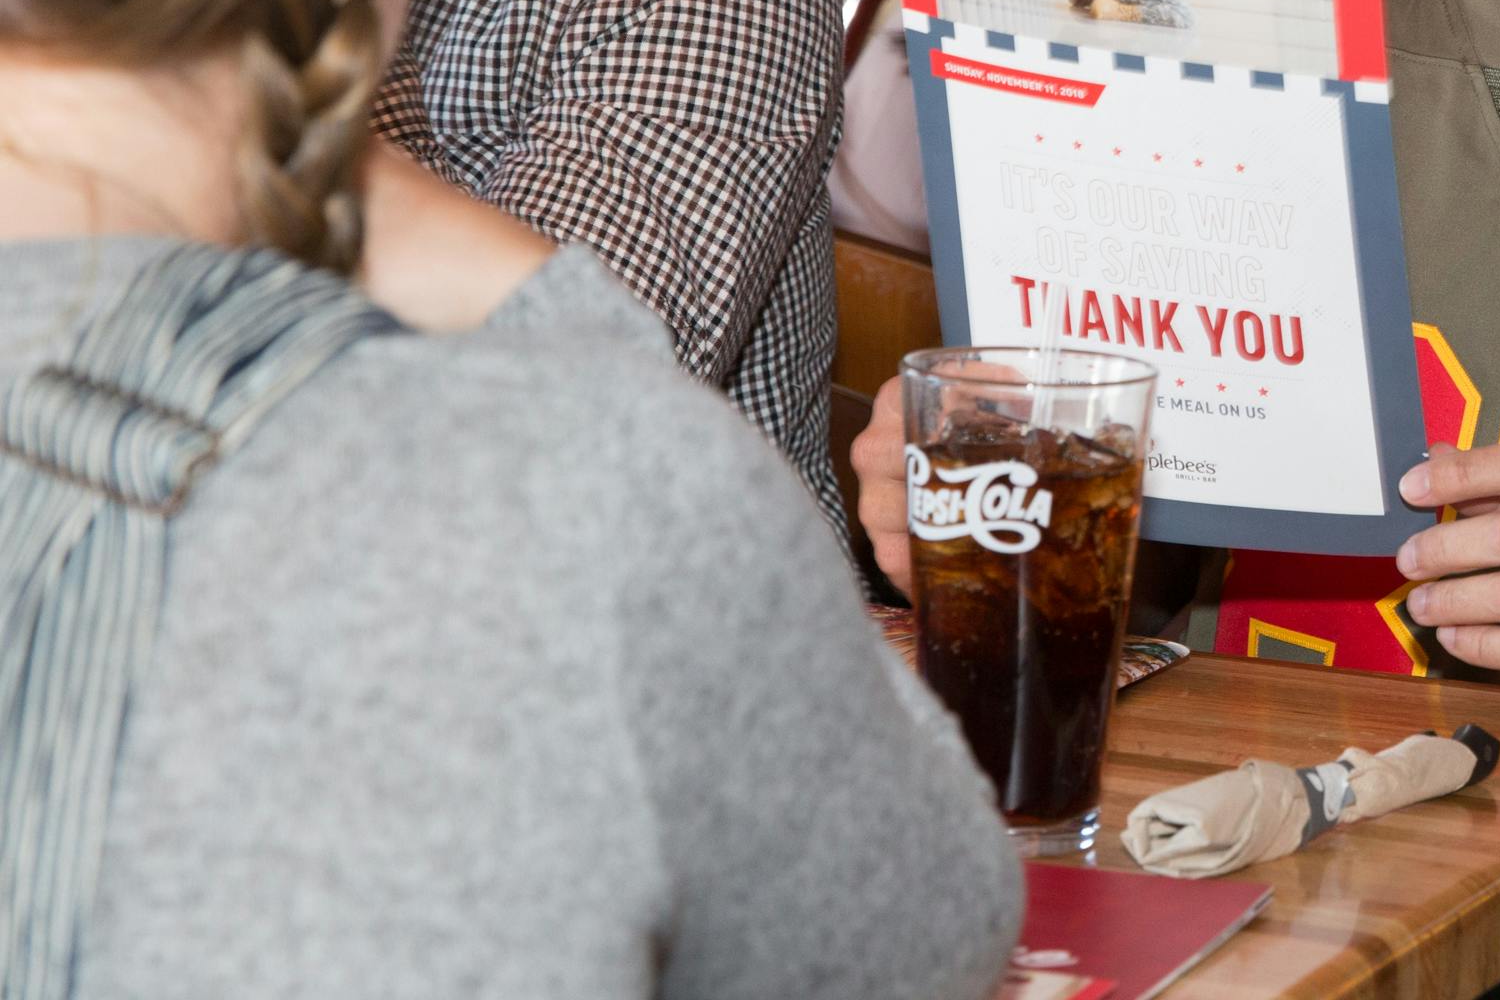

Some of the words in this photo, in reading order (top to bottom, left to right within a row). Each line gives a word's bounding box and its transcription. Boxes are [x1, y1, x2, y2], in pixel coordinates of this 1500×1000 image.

[986, 72, 1044, 92] NOVEMBER
[1000, 161, 1078, 221] IT'S
[1087, 178, 1181, 238] OUR
[1187, 191, 1296, 250] WAY
[1034, 225, 1088, 279] OF
[1098, 236, 1267, 303] SAYING
[1195, 304, 1305, 367] YOU
[1170, 397, 1214, 415] MEAL
[1219, 402, 1241, 417] ON
[1245, 406, 1267, 420] US
